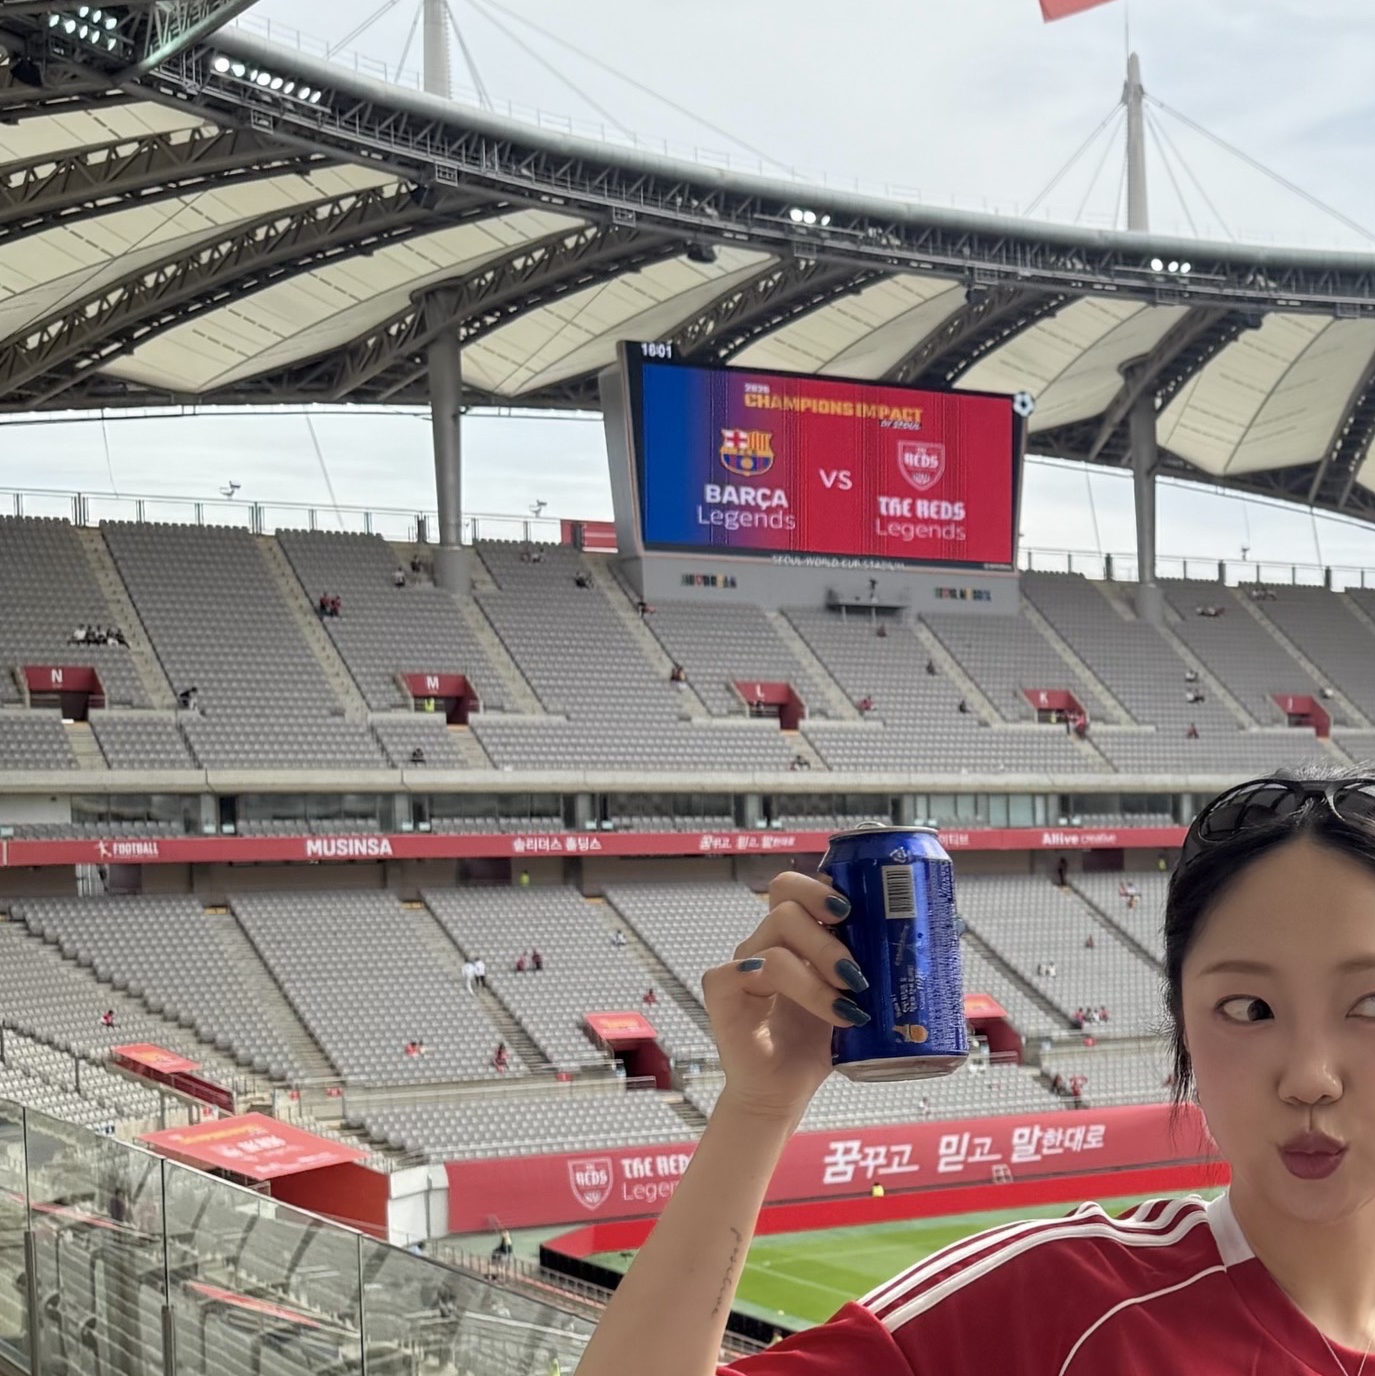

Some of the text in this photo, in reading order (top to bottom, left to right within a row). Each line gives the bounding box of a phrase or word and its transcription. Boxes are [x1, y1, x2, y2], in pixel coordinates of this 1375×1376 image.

[744, 394, 923, 422] CHAMPIONS IMPACT
[819, 467, 853, 490] VS
[705, 484, 788, 510] BARÇA
[697, 505, 796, 530] Legends
[915, 498, 966, 521] REDS
[874, 516, 967, 541] Legends
[51, 669, 63, 682] N
[427, 676, 439, 689] M
[756, 683, 766, 697] L
[1039, 692, 1049, 704] K
[112, 842, 159, 856] FOOTBALL
[306, 838, 394, 858] MUSINSA
[655, 1153, 694, 1177] RED
[822, 1124, 1106, 1185] 꿈꾸고 믿고 말한대로
